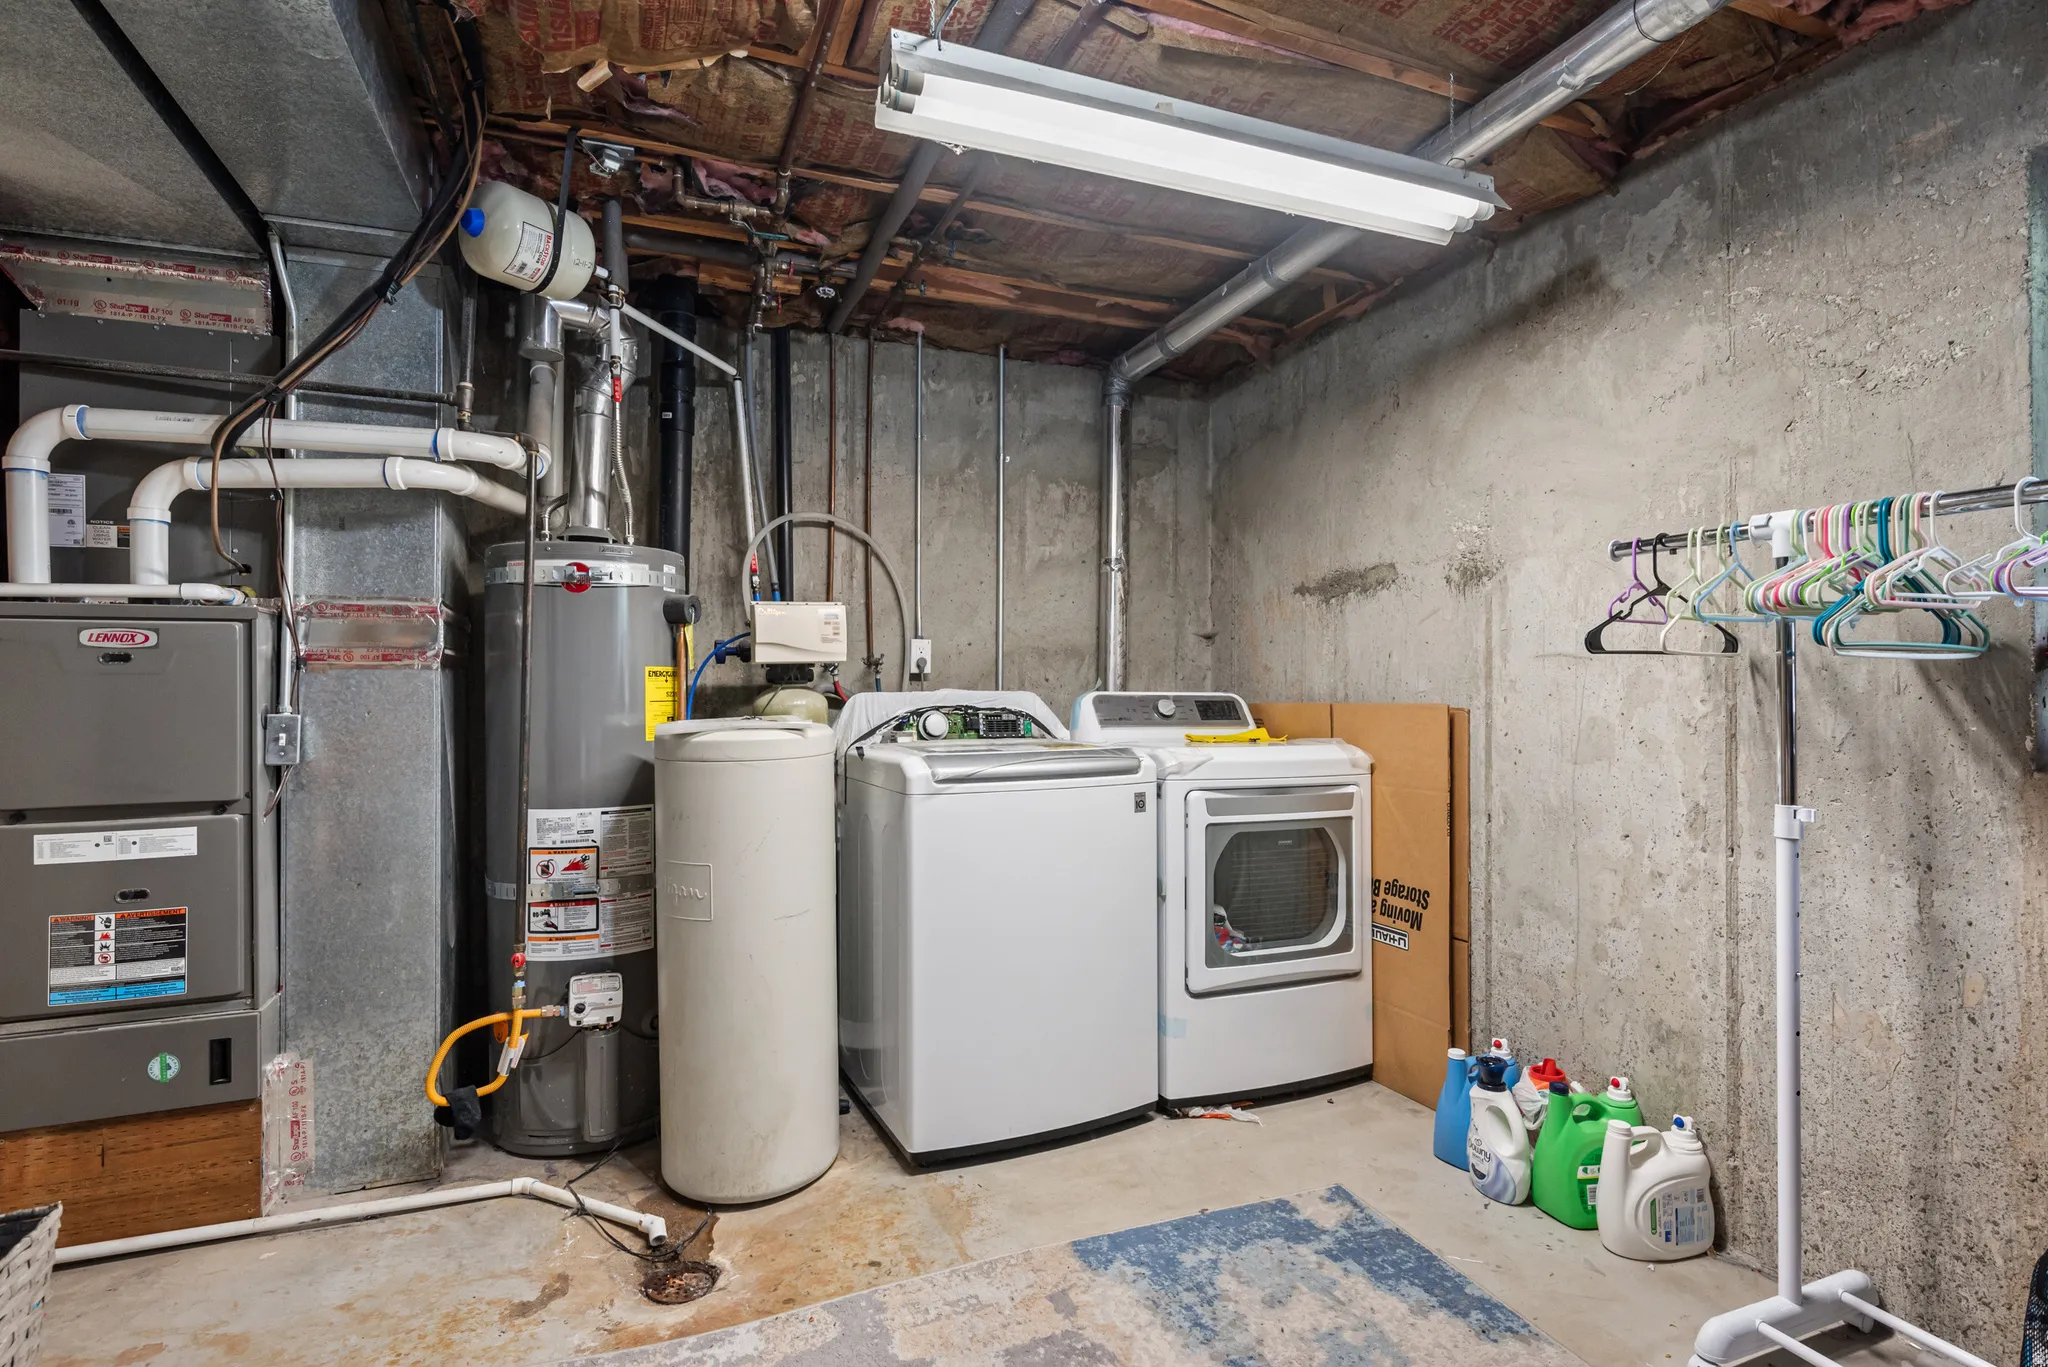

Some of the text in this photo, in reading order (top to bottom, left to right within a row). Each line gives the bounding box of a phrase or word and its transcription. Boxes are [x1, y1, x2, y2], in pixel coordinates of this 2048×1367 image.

[208, 268, 219, 276] 100
[56, 300, 79, 308] 01/19
[109, 302, 144, 313] Shurtape
[150, 307, 160, 315] AF
[161, 309, 173, 317] 100
[194, 311, 226, 322] Shurtape
[109, 310, 133, 318] 181A-P
[194, 320, 217, 328] 181A-P
[87, 632, 138, 643] LENNOX
[1383, 878, 1431, 911] Storage
[126, 908, 182, 918] AVERTISSEMENT
[1379, 898, 1424, 932] Moving
[1469, 1138, 1491, 1163] Downy
